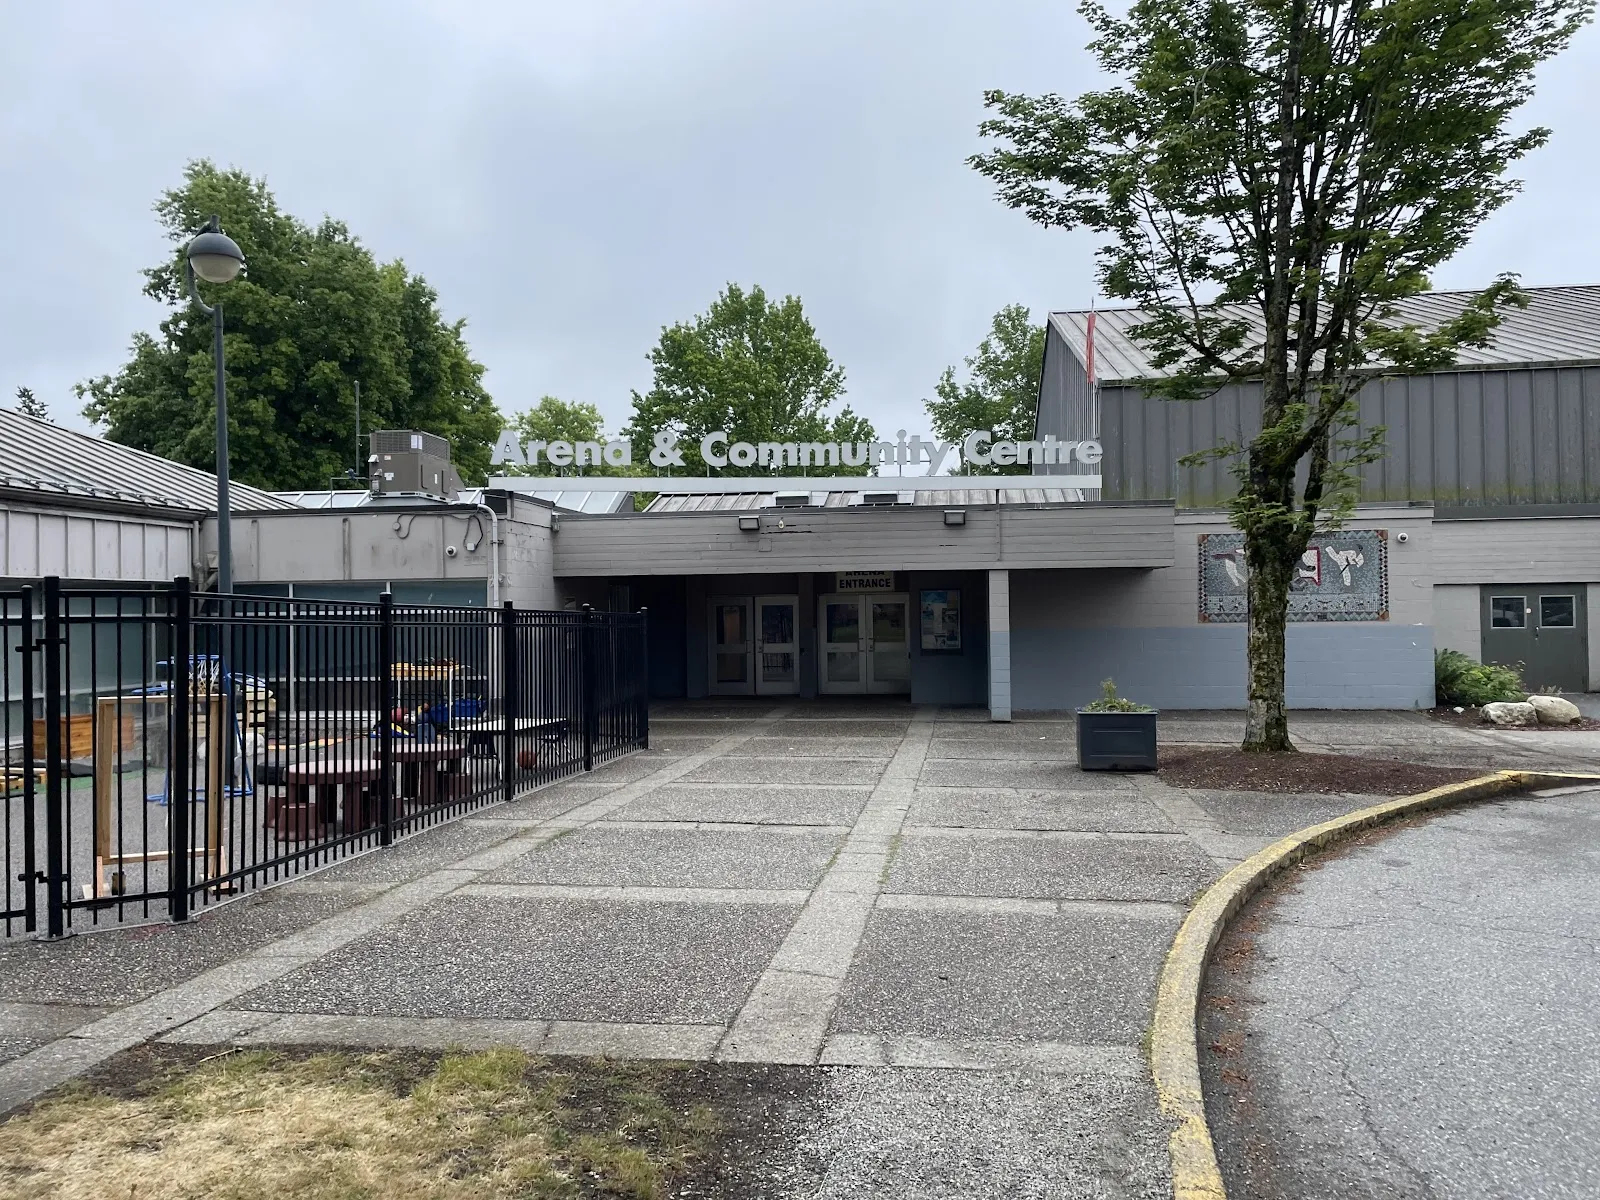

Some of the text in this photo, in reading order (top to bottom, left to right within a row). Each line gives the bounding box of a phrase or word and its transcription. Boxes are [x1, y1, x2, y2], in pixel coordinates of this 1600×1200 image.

[490, 429, 1103, 476] Arena & Community Centre
[840, 579, 891, 589] ENTRANCE
